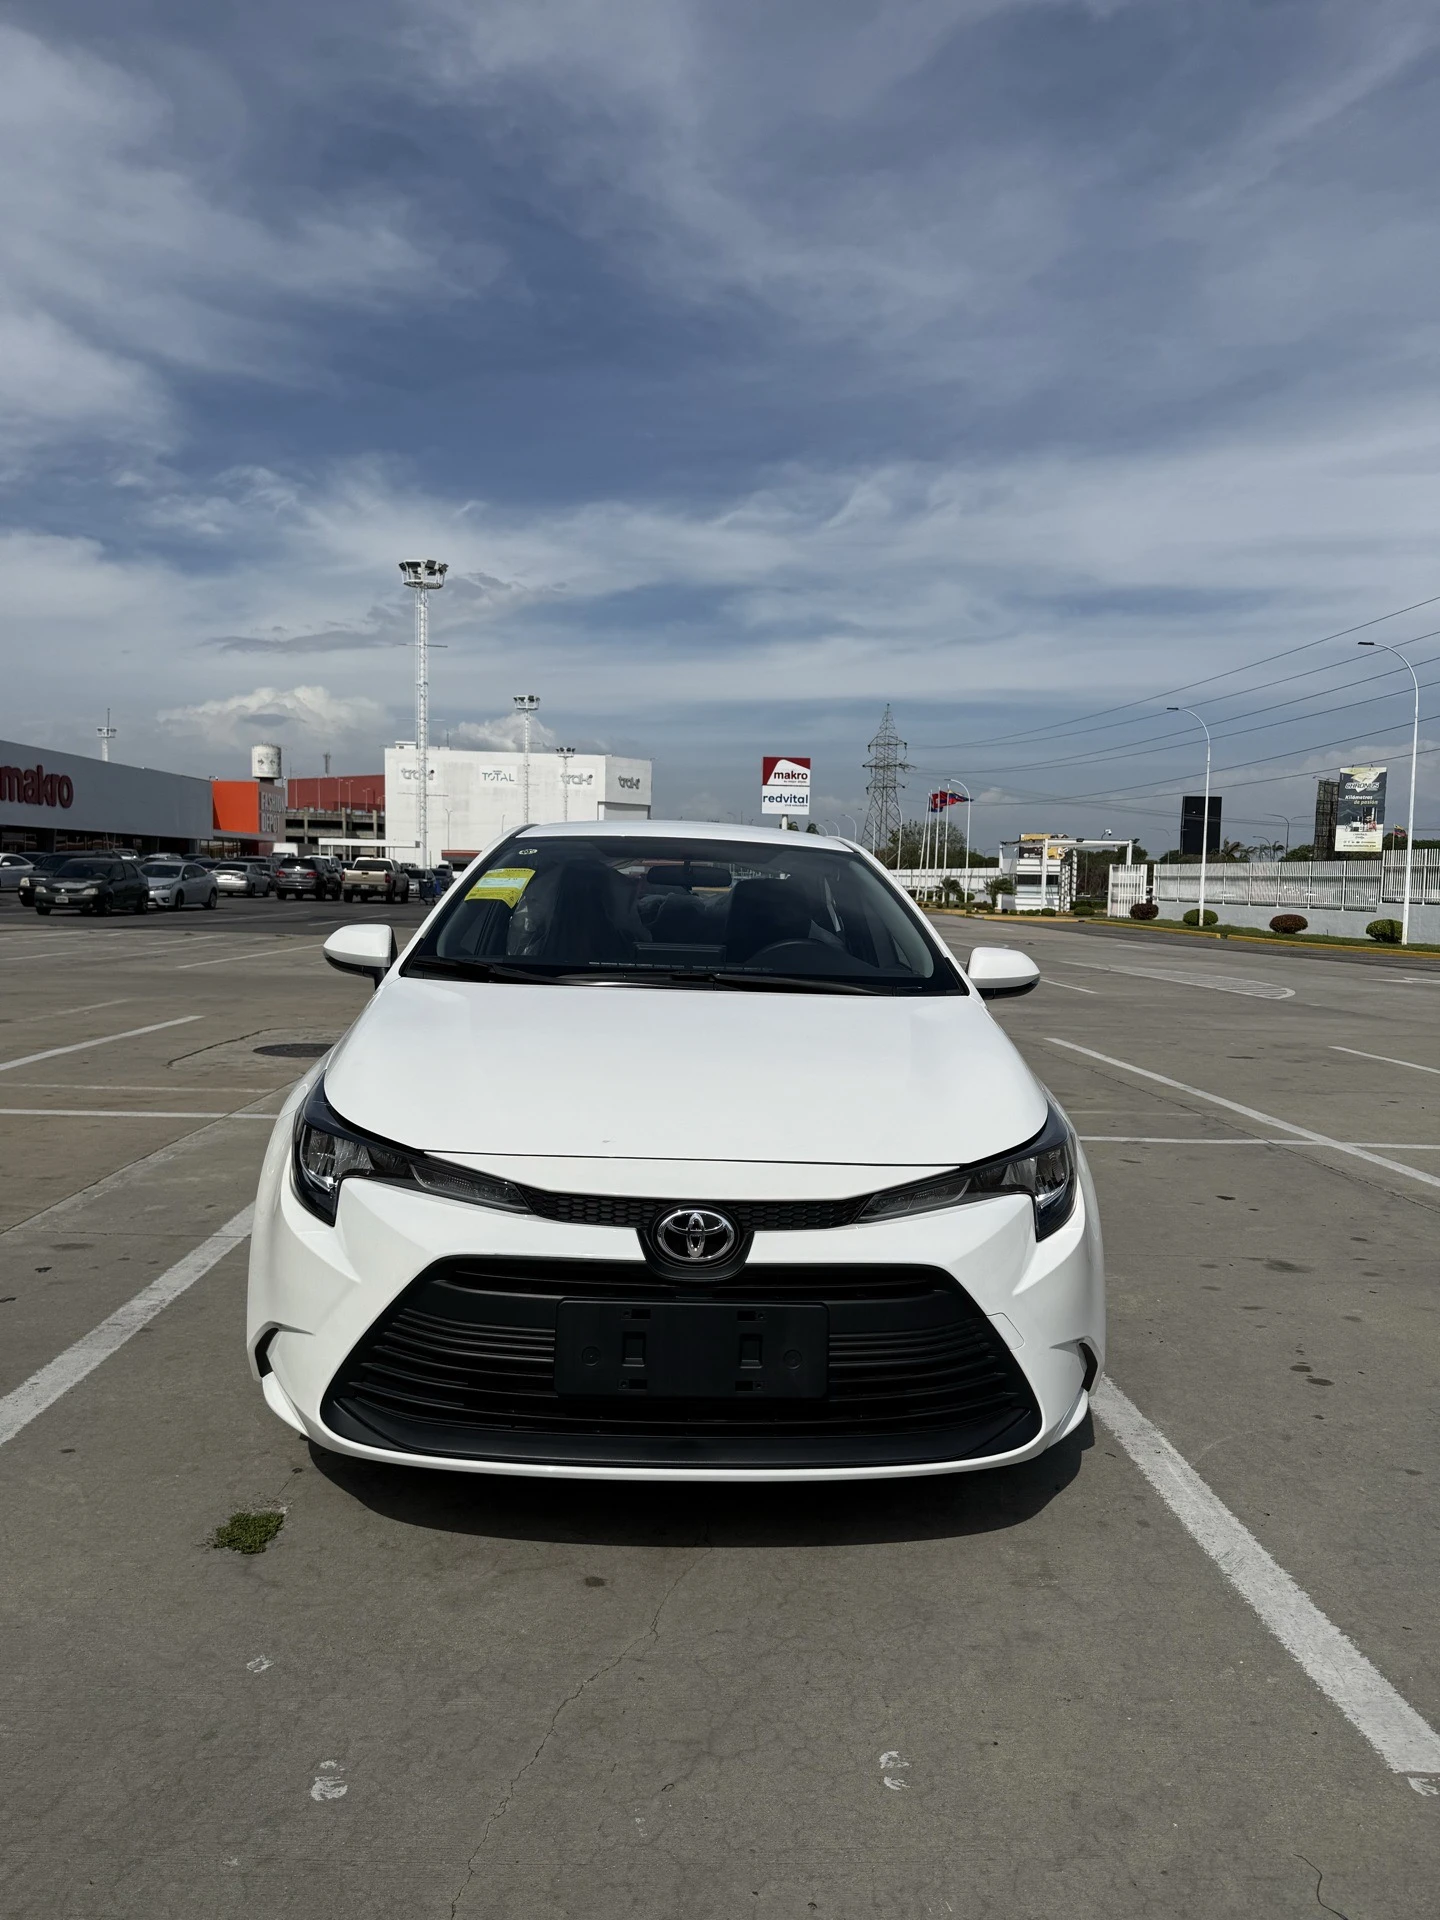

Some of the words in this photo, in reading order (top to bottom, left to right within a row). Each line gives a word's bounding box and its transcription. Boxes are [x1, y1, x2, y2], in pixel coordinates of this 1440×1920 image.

[482, 772, 515, 782] TOTAL
[774, 771, 808, 780] makro
[0, 764, 74, 809] makro
[261, 791, 287, 815] FASHION
[763, 794, 808, 804] redvital
[261, 813, 280, 834] DEPOT
